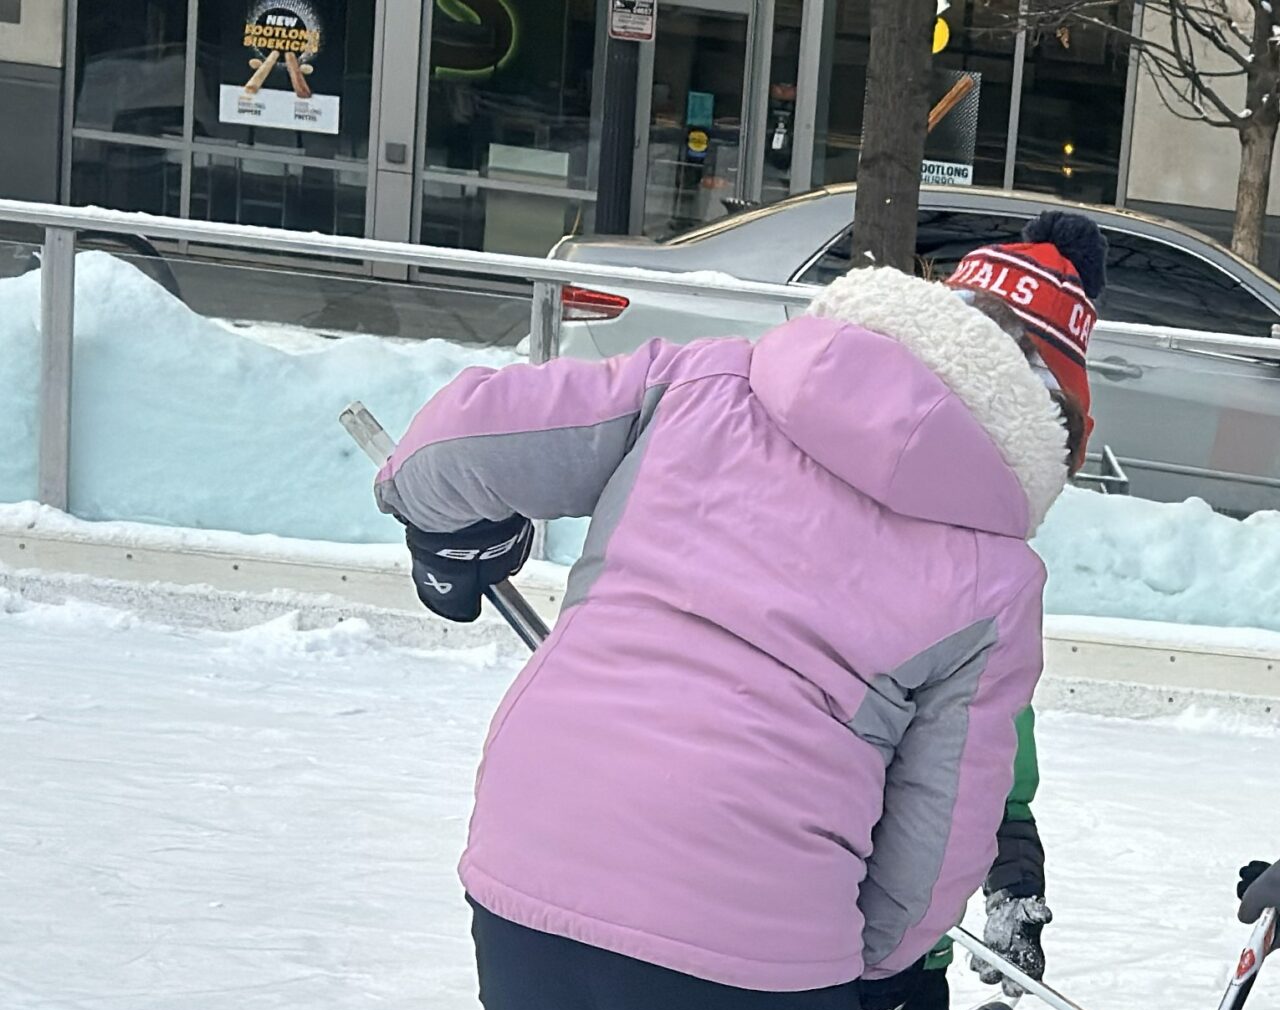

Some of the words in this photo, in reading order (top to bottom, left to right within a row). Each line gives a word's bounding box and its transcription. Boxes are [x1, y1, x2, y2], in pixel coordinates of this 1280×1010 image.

[266, 14, 298, 27] NEW
[244, 23, 319, 41] FOOTLONG
[243, 34, 319, 54] SIDEKICKS
[920, 162, 969, 179] OOTLONG
